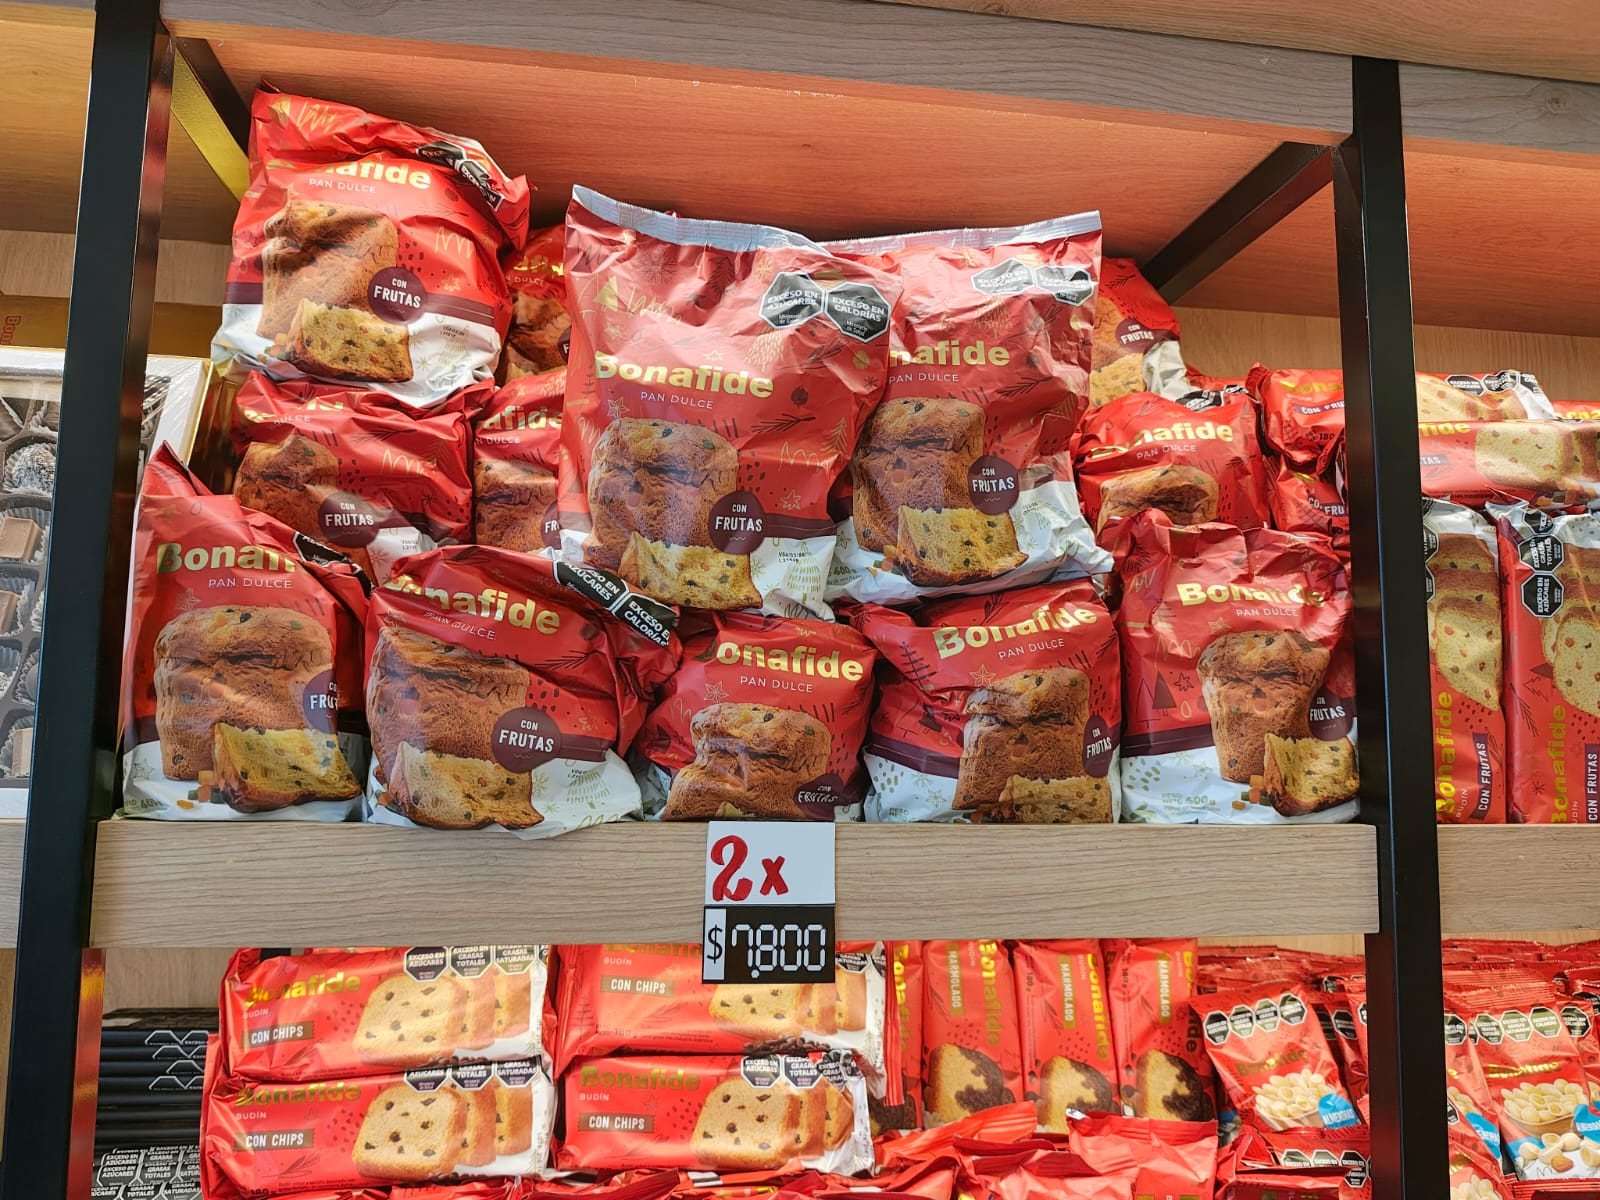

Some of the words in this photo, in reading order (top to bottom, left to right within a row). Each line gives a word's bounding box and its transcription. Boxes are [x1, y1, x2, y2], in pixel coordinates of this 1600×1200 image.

[309, 178, 333, 188] PAN
[337, 181, 377, 194] DULCE
[391, 277, 408, 289] CON
[373, 285, 421, 309] FRUTAS
[832, 296, 870, 310] EXCESO
[871, 306, 885, 315] EN
[1120, 331, 1154, 345] FRUTAS
[594, 350, 775, 399] Bonafide
[889, 372, 914, 384] PAN
[918, 371, 960, 383] DULCE
[640, 391, 667, 403] PAN
[670, 394, 713, 411] DULCE
[487, 436, 521, 444] DULCE
[981, 467, 996, 477] CON
[972, 476, 1015, 493] FRUTAS
[339, 502, 356, 511] CON
[732, 503, 747, 514] CON
[324, 513, 374, 528] FRUTAS
[715, 516, 763, 533] FRUTAS
[208, 577, 237, 589] PAN
[243, 577, 292, 589] DULCE
[605, 581, 621, 595] EN
[628, 600, 663, 633] EXCESO
[1236, 608, 1260, 617] PAN
[1263, 608, 1299, 617] DULCE
[452, 621, 496, 641] DULCE
[999, 646, 1025, 661] PAN
[1028, 638, 1065, 654] DULCE
[716, 641, 864, 682] onafide
[740, 675, 767, 688] PAN
[771, 679, 814, 693] DULCE
[1310, 706, 1346, 722] FRUTAS
[520, 719, 539, 731] CON
[498, 729, 555, 753] FRUTAS
[1086, 736, 1112, 760] FRUTAS
[1475, 742, 1492, 785] FRUTAS
[1586, 752, 1598, 794] FRUTAS
[1478, 789, 1490, 811] CON
[1587, 794, 1598, 821] CON
[456, 958, 486, 967] TOTALES
[457, 952, 484, 960] GRASAS
[610, 979, 632, 991] CON
[635, 980, 667, 994] CHIPS
[949, 950, 961, 1009] MARMOLADO
[1062, 963, 1074, 1023] MARMOLADO
[1159, 959, 1170, 1018] MARMOLADO
[251, 1030, 270, 1045] CON
[272, 1025, 304, 1041] CHIPS
[579, 1065, 700, 1092] Bonafide
[588, 1115, 610, 1129] CON
[613, 1116, 646, 1130] CHIPS
[245, 1134, 268, 1148] CON
[272, 1131, 304, 1146] CHIPS
